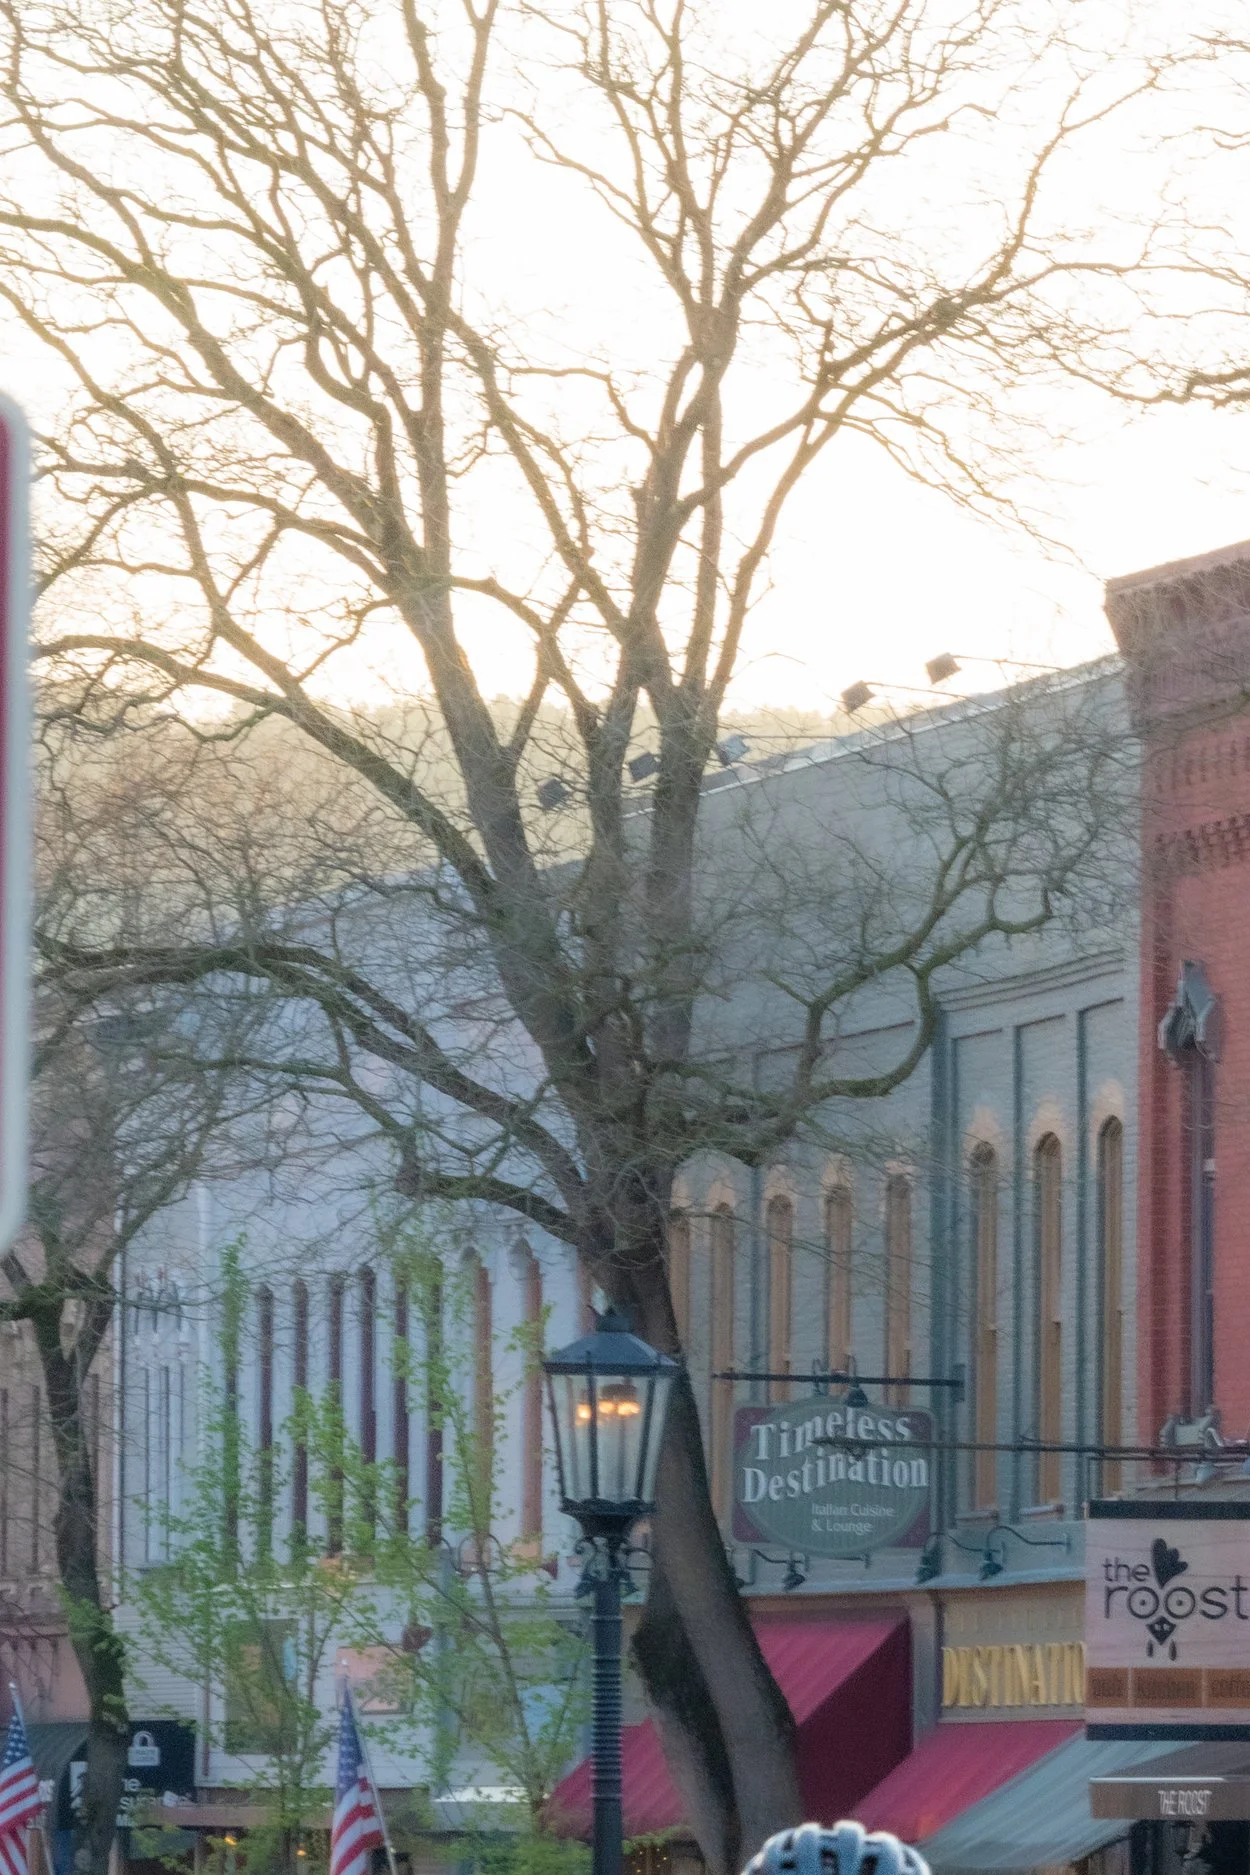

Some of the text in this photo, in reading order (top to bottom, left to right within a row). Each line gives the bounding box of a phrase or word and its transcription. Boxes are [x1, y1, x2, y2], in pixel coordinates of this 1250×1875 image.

[751, 1407, 912, 1460] Timeless
[743, 1446, 929, 1502] Destination
[811, 1503, 896, 1517] Italian Cuisine
[811, 1519, 874, 1536] & Lounge
[1103, 1557, 1150, 1582] the
[1104, 1575, 1249, 1620] roost
[1158, 1790, 1213, 1815] THE ROOST
